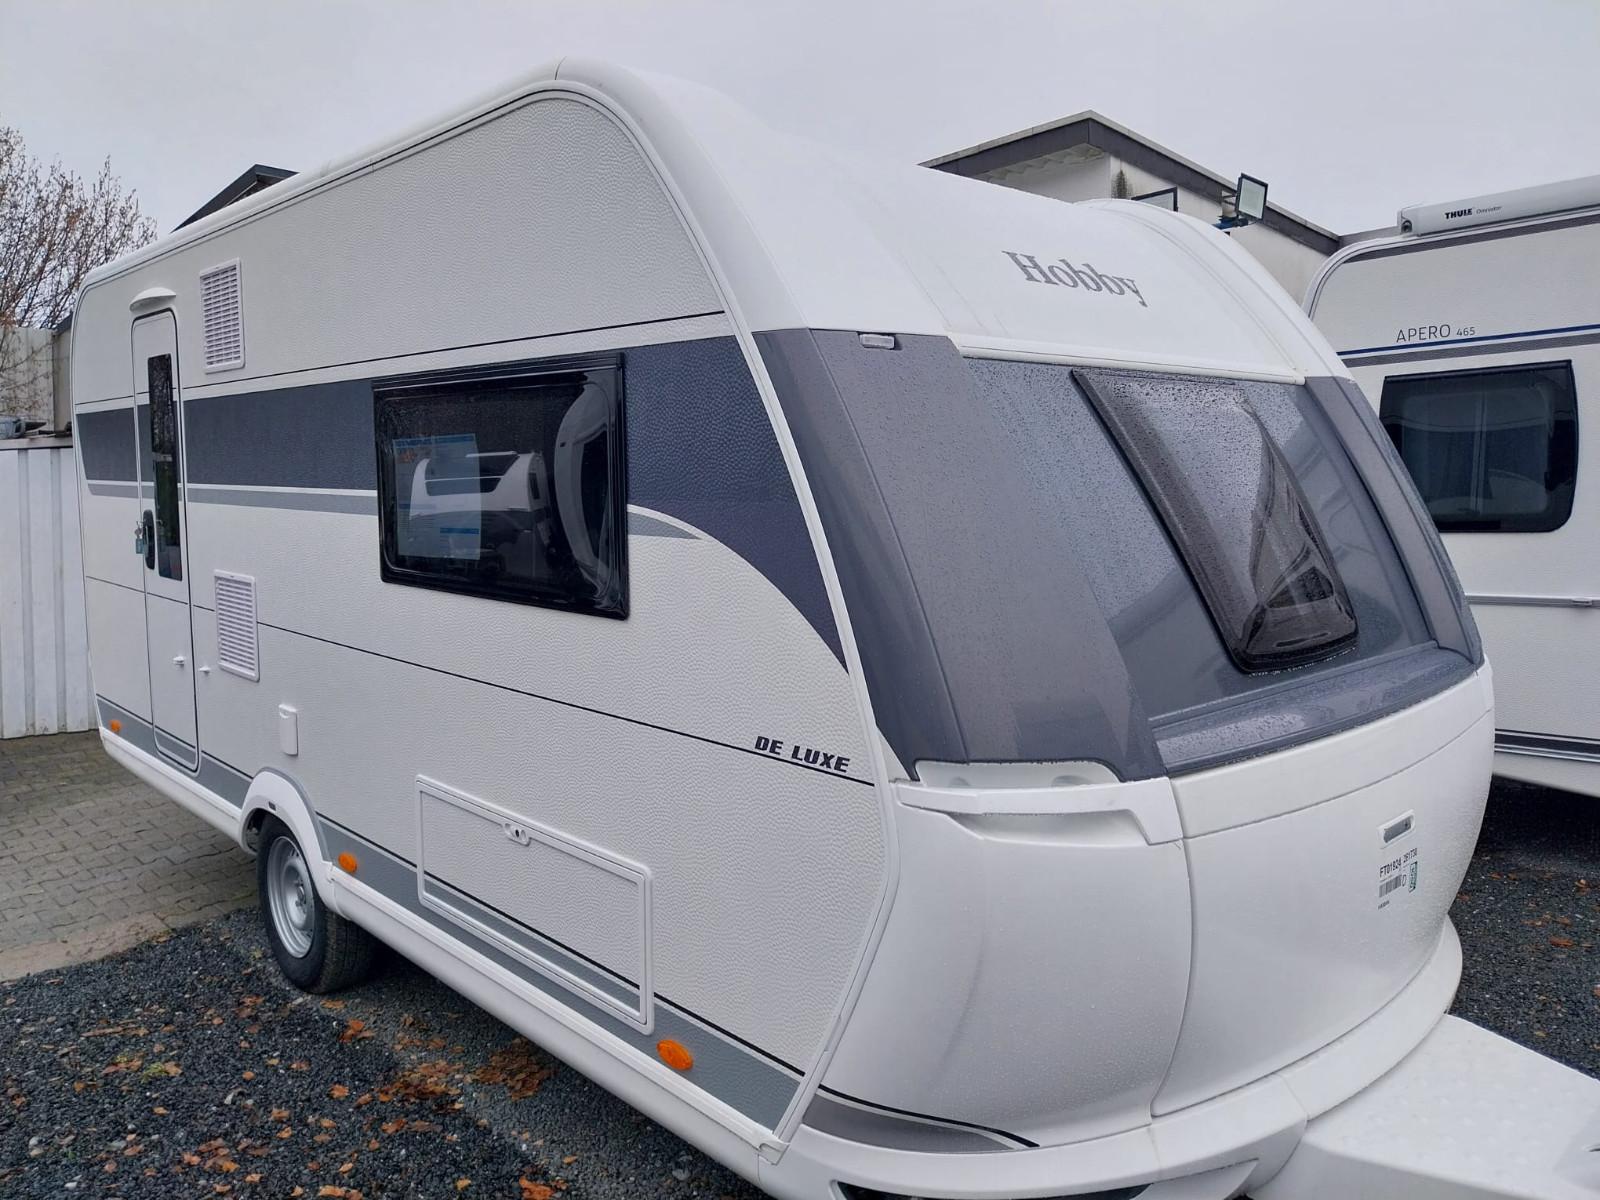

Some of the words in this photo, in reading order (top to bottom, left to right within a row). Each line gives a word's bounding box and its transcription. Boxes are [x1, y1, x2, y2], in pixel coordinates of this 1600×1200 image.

[1445, 208, 1472, 219] THULE
[1002, 251, 1148, 308] Hobby
[1396, 324, 1450, 343] APERO
[1457, 327, 1475, 337] 465
[754, 736, 783, 755] DE
[791, 745, 850, 773] LUXE
